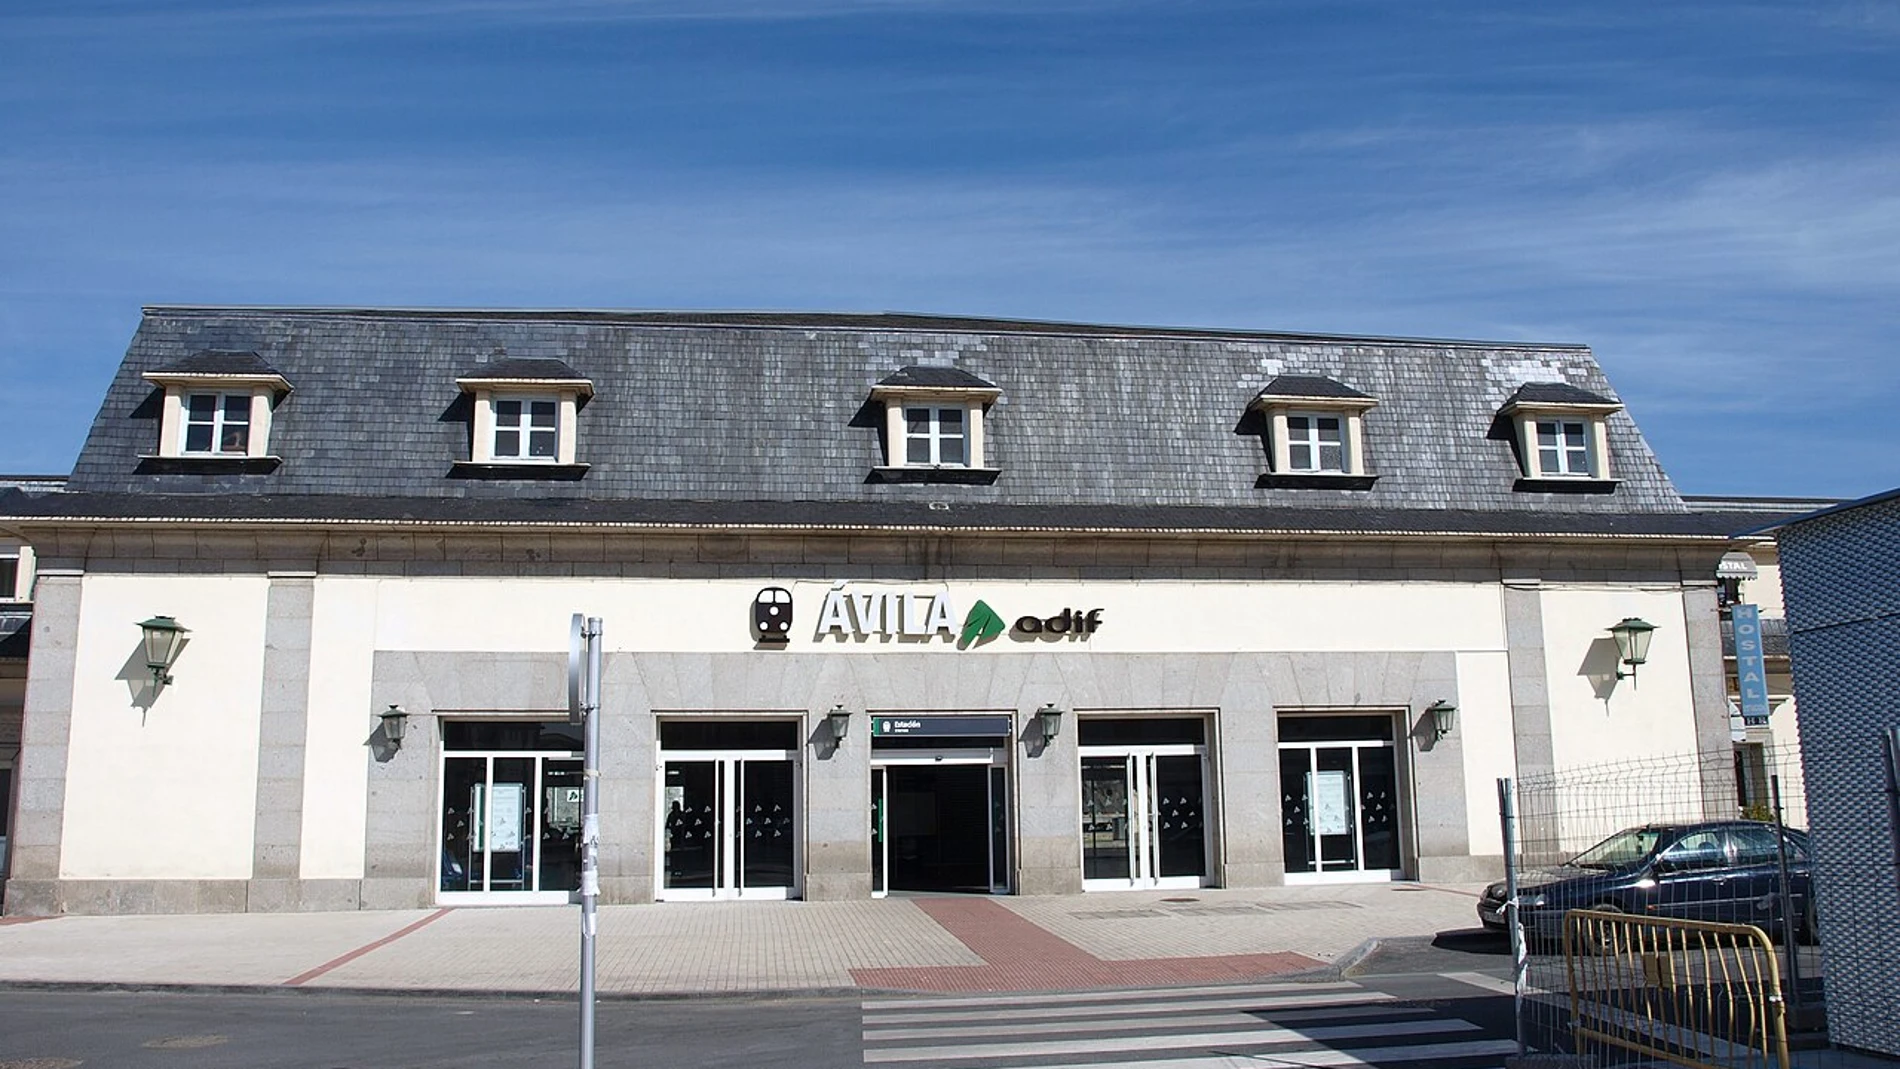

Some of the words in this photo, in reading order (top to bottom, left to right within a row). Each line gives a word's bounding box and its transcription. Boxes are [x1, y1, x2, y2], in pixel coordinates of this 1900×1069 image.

[1719, 562, 1748, 570] STAL
[818, 580, 958, 634] ÁVILA
[1016, 608, 1104, 633] adif
[1737, 606, 1761, 699] HOSTAL
